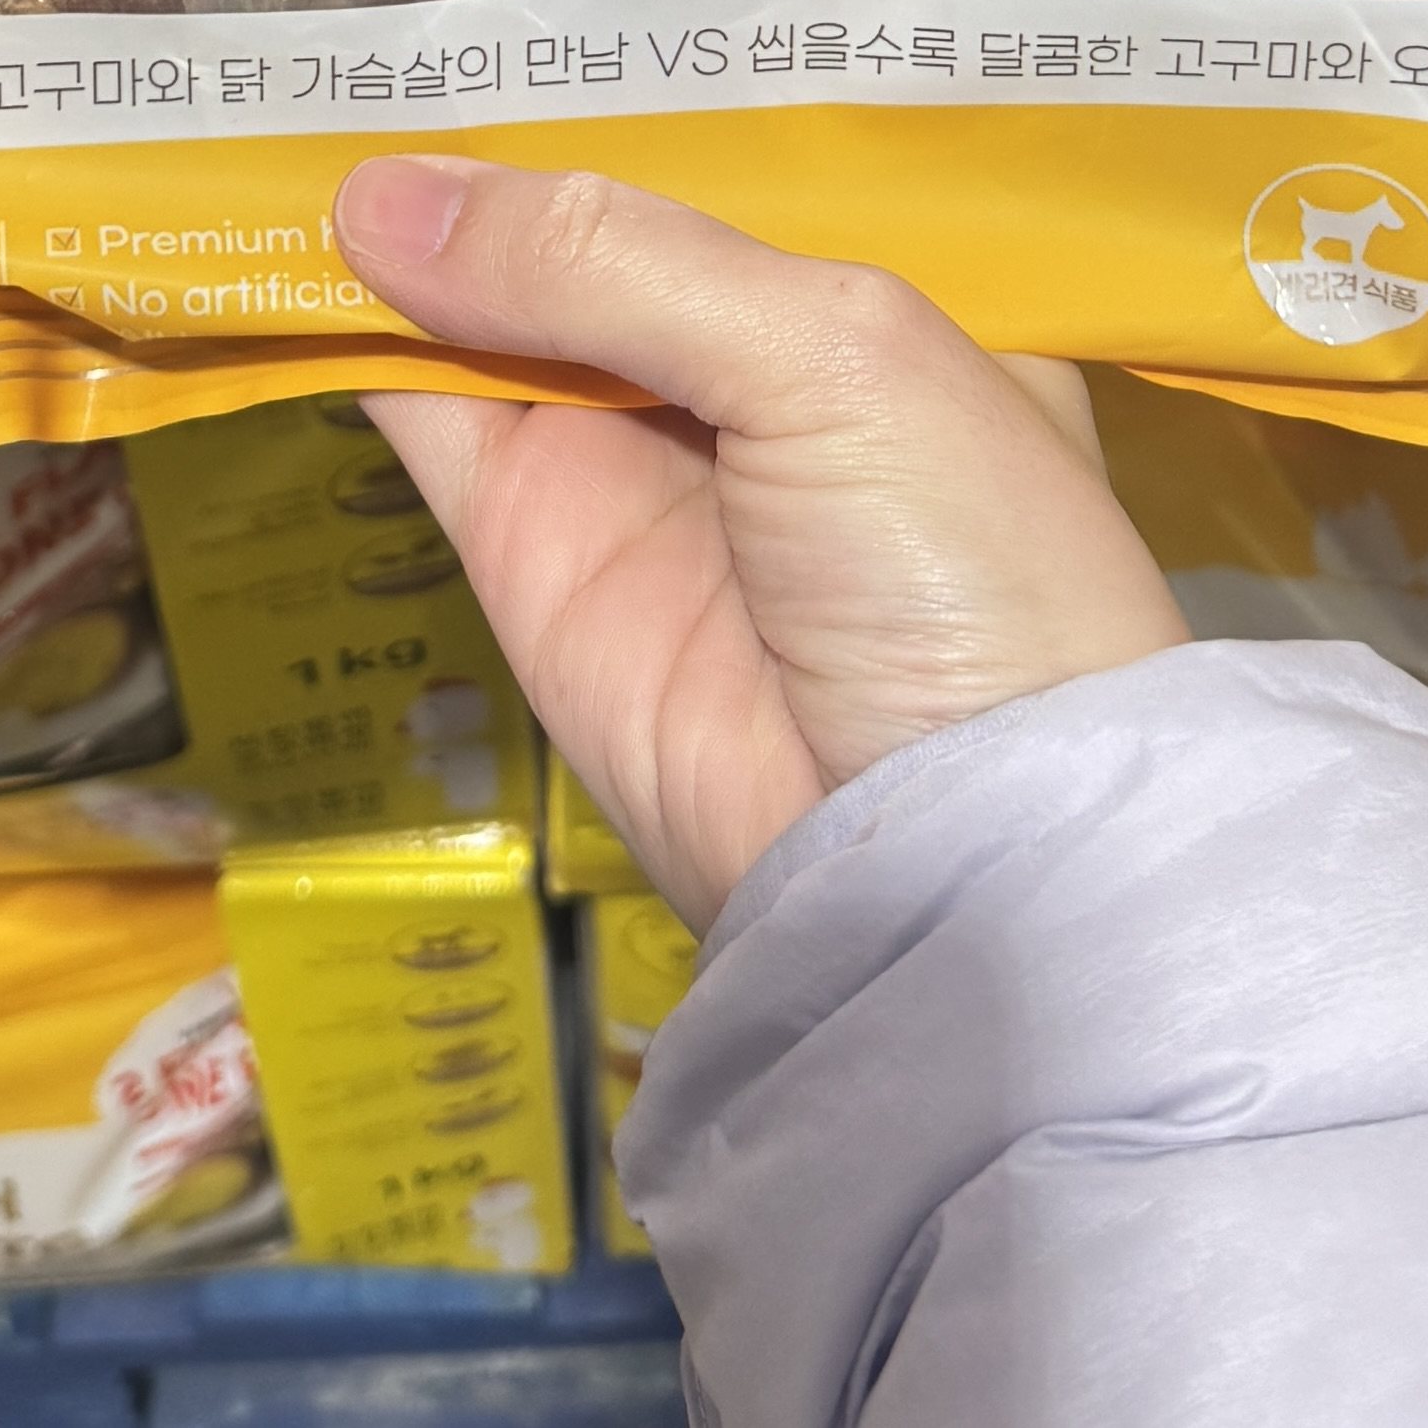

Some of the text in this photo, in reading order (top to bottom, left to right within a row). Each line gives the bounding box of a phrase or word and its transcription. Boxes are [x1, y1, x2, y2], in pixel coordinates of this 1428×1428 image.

[218, 54, 271, 104] 닭
[291, 40, 504, 104] 가슴살의
[524, 32, 631, 90] 만남
[646, 27, 730, 76] VS
[746, 20, 960, 80] 씹을수록
[979, 29, 1139, 82] 달콤한
[1158, 36, 1375, 87] 고구마와
[97, 219, 308, 258] Premium
[102, 281, 169, 317] No
[1362, 277, 1419, 314] 식품
